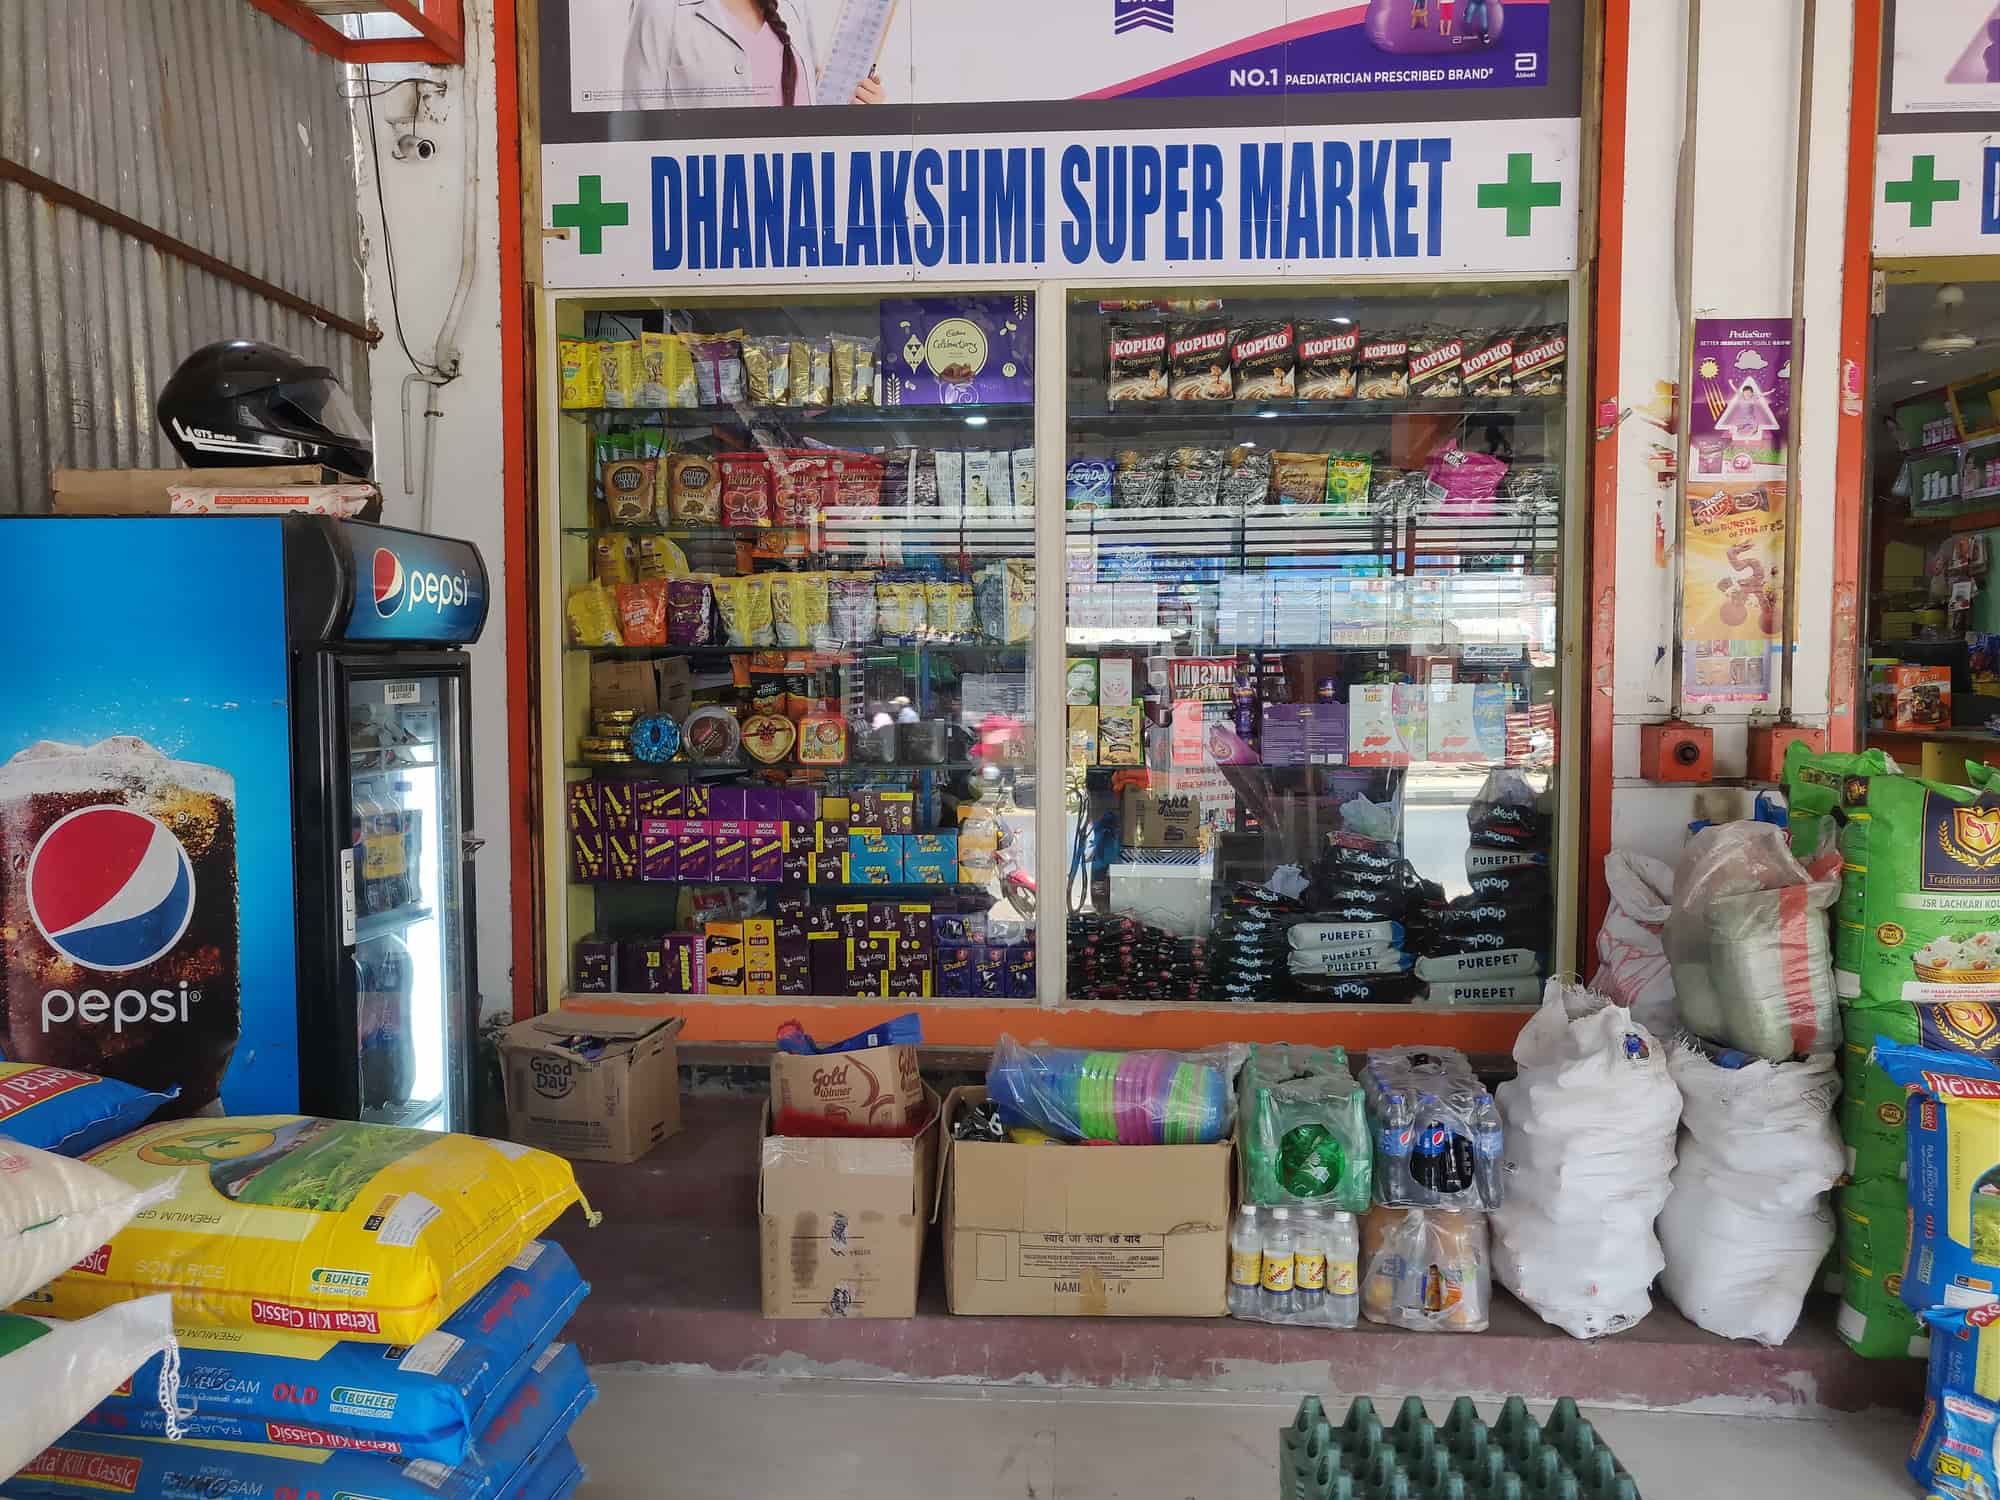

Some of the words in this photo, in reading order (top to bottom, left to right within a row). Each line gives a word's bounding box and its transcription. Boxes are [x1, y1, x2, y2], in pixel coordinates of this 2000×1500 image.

[1230, 69, 1279, 88] NO.1
[1285, 72, 1373, 86] PAEDIATRICIAN
[1374, 69, 1445, 84] PRESCRIBED
[651, 148, 1046, 271] DHANALAKSHMI
[1060, 144, 1224, 265] SUPER
[1239, 138, 1452, 260] MARKET
[1114, 336, 1166, 356] KOPIKO
[1175, 333, 1226, 353] KOPIKO
[1236, 334, 1288, 358] KOPIKO
[1304, 335, 1356, 356] KOPIKO
[1363, 344, 1407, 358] KOPIKO
[1410, 343, 1462, 375] KOPIKO
[1461, 343, 1512, 374] KOPIKO
[1513, 340, 1565, 371] KOPIKO
[408, 568, 468, 615] pepsi
[1472, 855, 1522, 866] PUREPET
[1928, 874, 1981, 885] Traditional
[344, 859, 354, 933] PULL
[1939, 898, 1983, 909] LACHKARI
[1320, 930, 1373, 942] PUREPET
[1326, 961, 1378, 973] PUREPET
[1458, 953, 1519, 970] PUREPET
[1334, 982, 1369, 999] drools
[1454, 987, 1516, 999] PUREPET
[41, 981, 190, 1033] pepsi
[530, 1056, 573, 1077] Good
[535, 1073, 568, 1093] Day
[812, 1063, 850, 1097] Gold
[160, 1211, 222, 1225] PREMIUM
[253, 1301, 304, 1328] Classic
[272, 1383, 319, 1405] OLD
[270, 1424, 325, 1446] Classic
[86, 1457, 136, 1487] Classic
